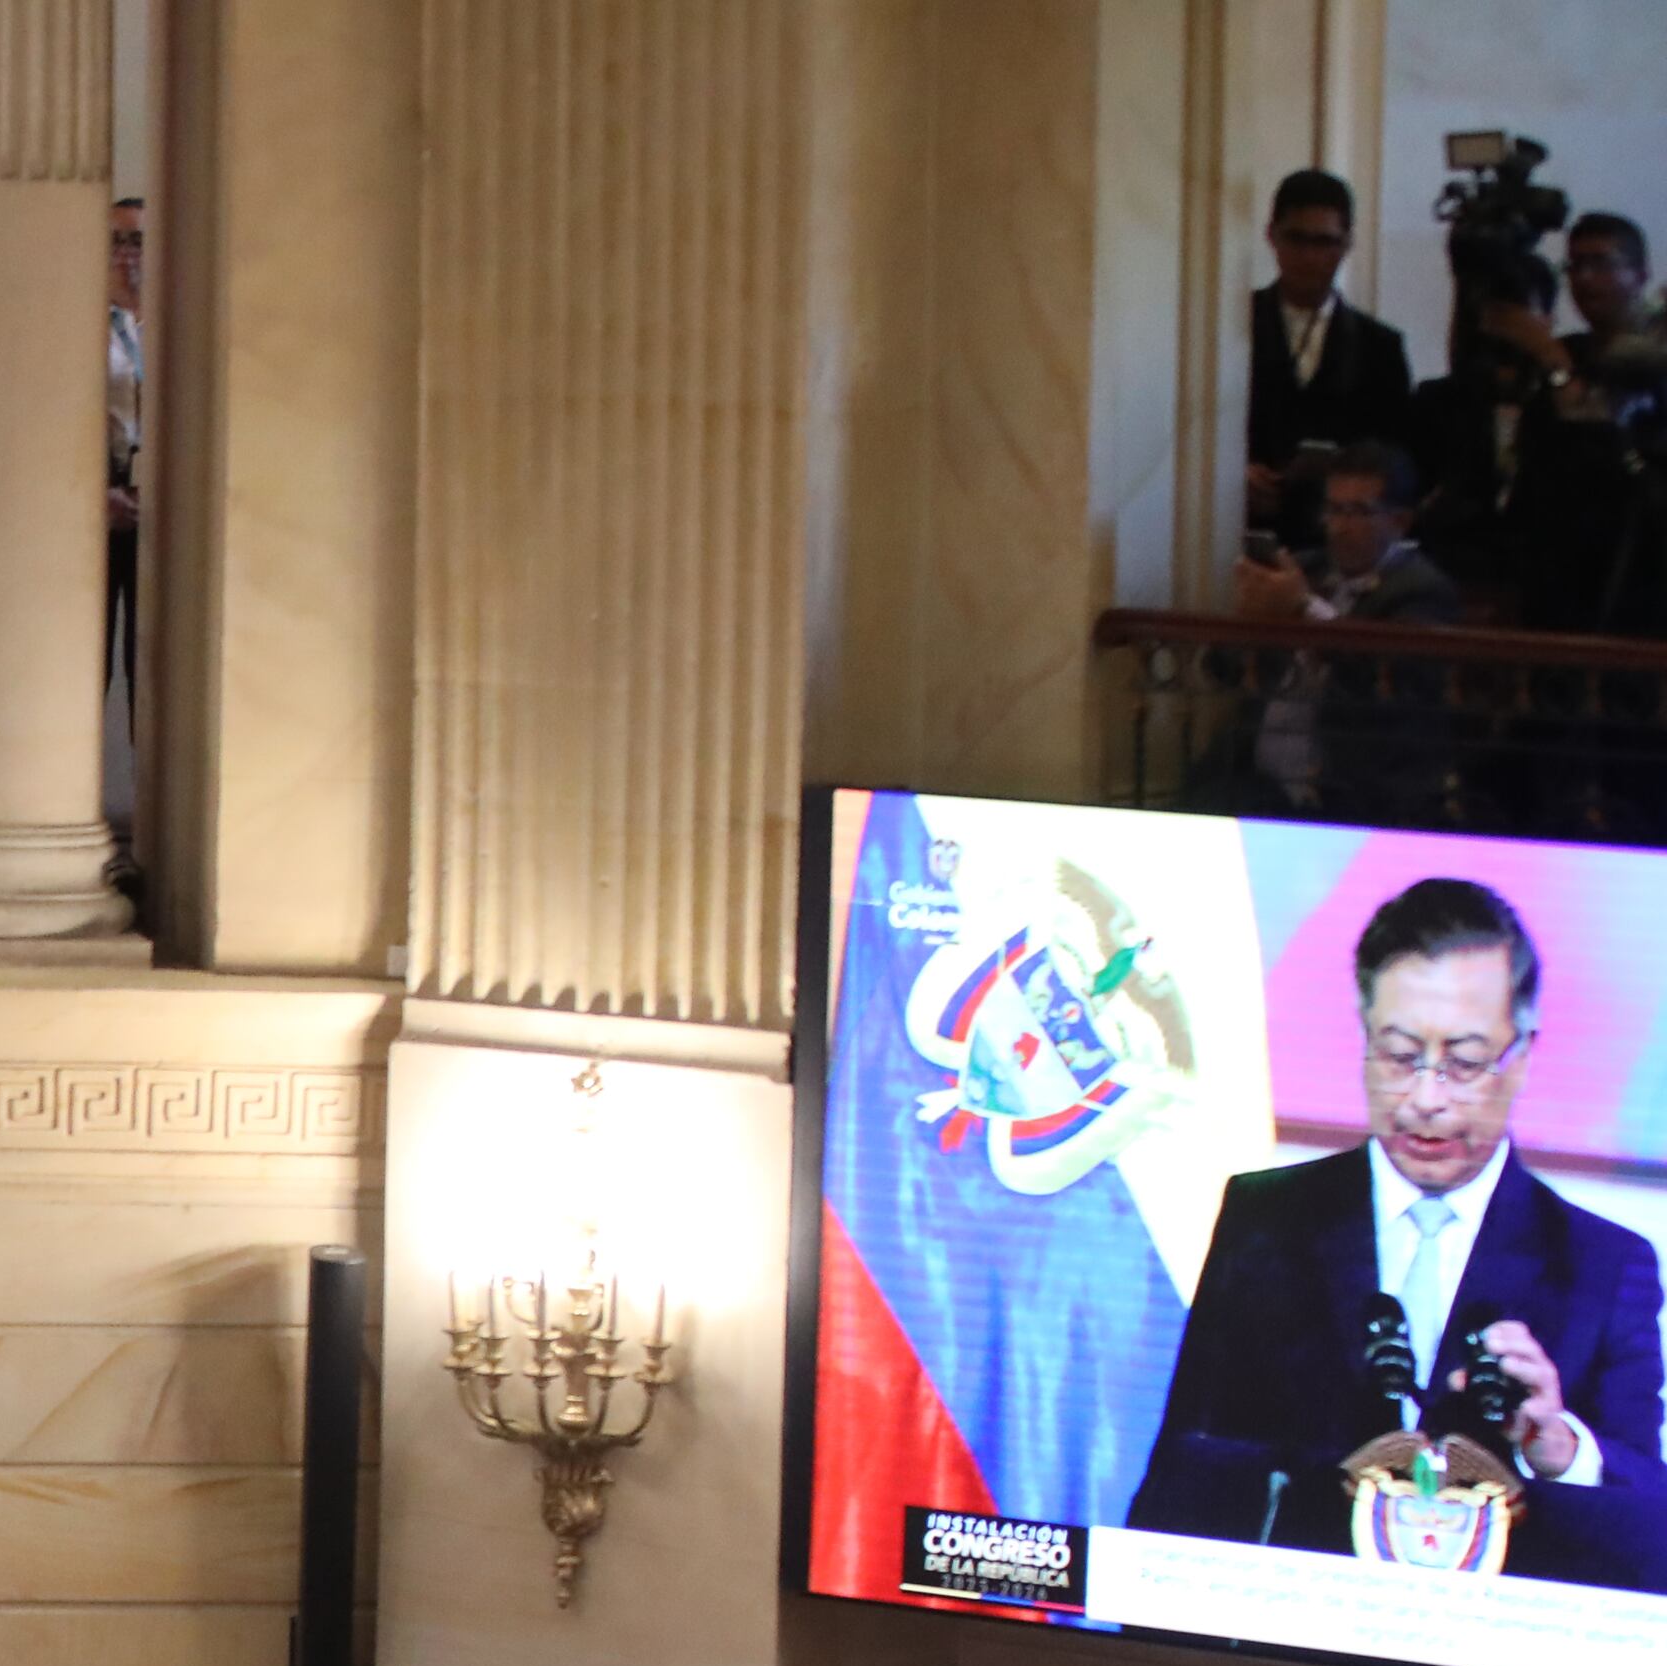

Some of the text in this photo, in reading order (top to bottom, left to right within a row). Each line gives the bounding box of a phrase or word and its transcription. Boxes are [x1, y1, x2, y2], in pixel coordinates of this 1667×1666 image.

[923, 1528, 1071, 1570] CONGRESO
[924, 1554, 950, 1573] DE
[951, 1557, 975, 1577] LA
